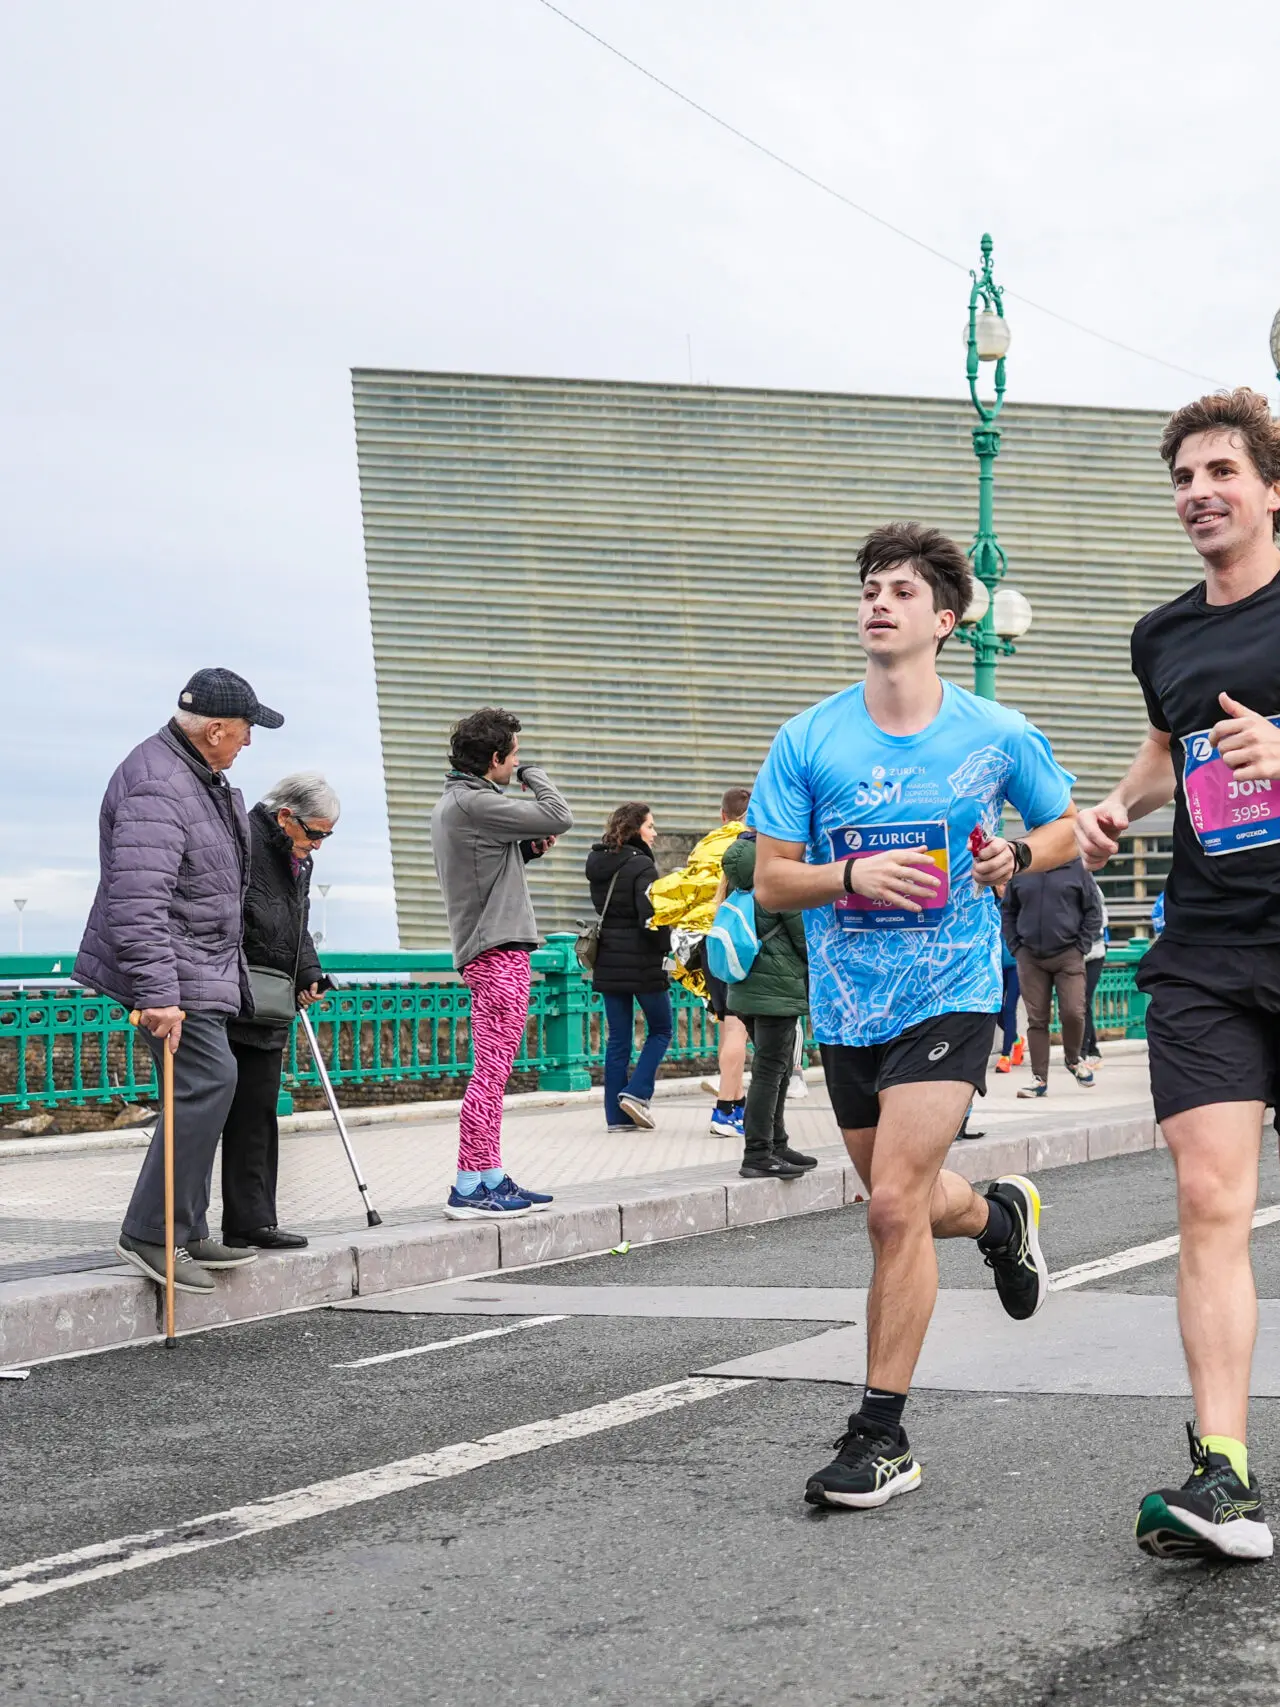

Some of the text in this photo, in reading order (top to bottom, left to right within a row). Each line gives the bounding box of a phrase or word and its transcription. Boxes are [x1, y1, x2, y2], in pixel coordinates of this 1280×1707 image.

[889, 766, 926, 777] ZURICH
[1227, 777, 1272, 799] JON
[1232, 802, 1271, 822] 3995
[868, 832, 926, 846] ZURICH
